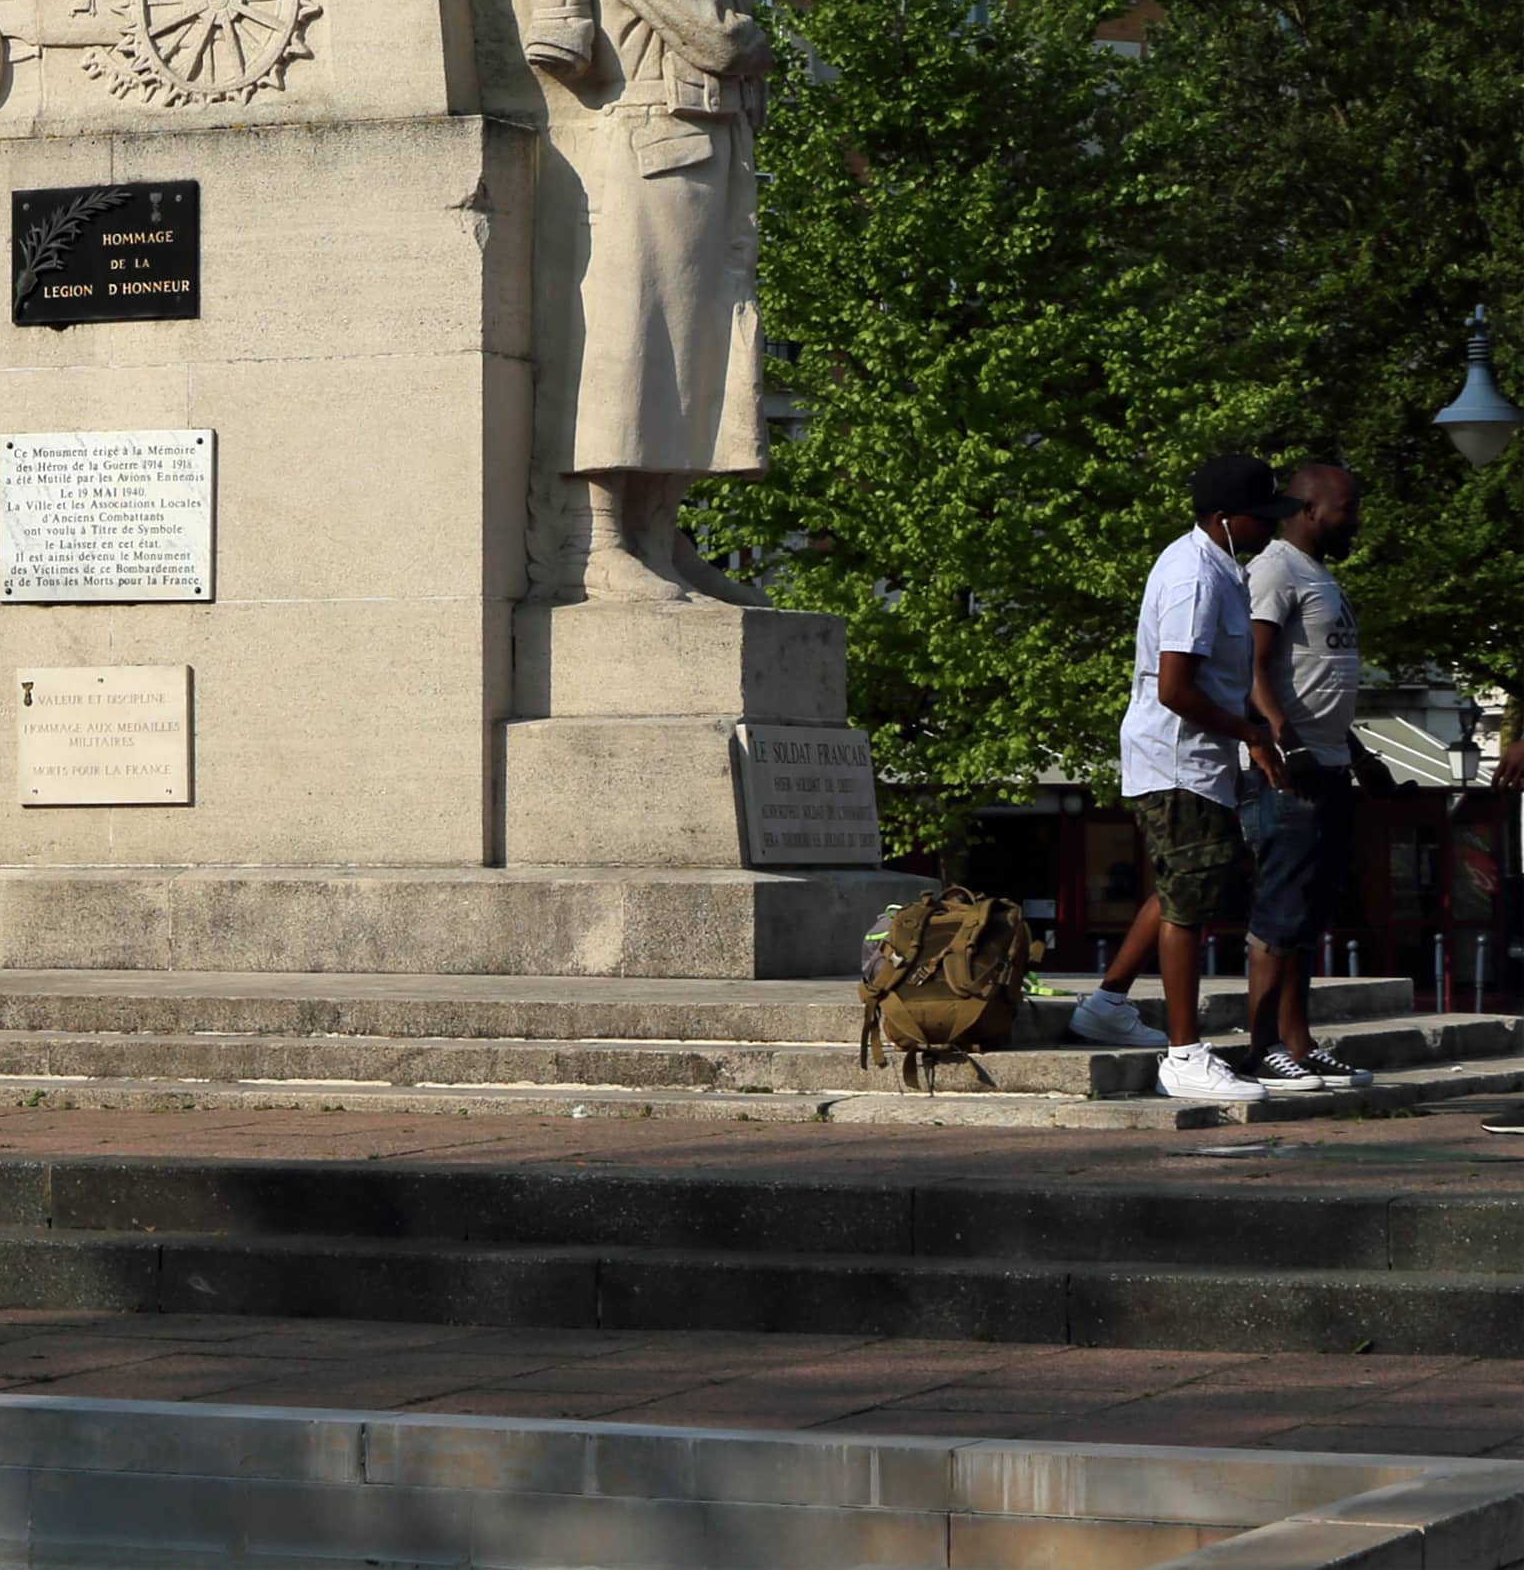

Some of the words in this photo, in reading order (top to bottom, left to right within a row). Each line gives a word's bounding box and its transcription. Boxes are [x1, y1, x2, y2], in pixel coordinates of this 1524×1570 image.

[102, 231, 174, 246] HOMMAGE
[110, 259, 126, 270] DE
[135, 258, 150, 268] LA
[44, 285, 93, 299] LEGION
[14, 449, 27, 458] Ce
[33, 448, 87, 458] Monument
[93, 447, 119, 460] érigé
[123, 447, 128, 455] à
[133, 446, 142, 455] la
[148, 446, 195, 455] Mémoire
[16, 462, 33, 472] des
[38, 462, 68, 472] Héros
[72, 462, 84, 471] de
[89, 461, 98, 470] la
[104, 460, 138, 470] Guerre
[143, 460, 162, 469] 1914
[17, 475, 32, 484] été
[38, 474, 71, 484] Mutilé
[77, 475, 94, 485] par
[100, 473, 112, 482] les
[118, 473, 151, 482] Avions
[157, 473, 204, 481] Ennemis
[61, 489, 74, 498] Le
[79, 488, 88, 497] 19
[94, 488, 117, 497] MAI
[7, 502, 20, 511] La
[26, 501, 52, 510] Ville
[57, 501, 66, 510] et
[72, 500, 85, 509] les
[90, 500, 155, 509] Associations
[160, 499, 201, 508] Locales
[42, 513, 94, 523] d'Anciens
[99, 513, 164, 521] Combattants
[24, 527, 41, 536] ont
[47, 526, 76, 535] voulu
[81, 525, 86, 535] à
[92, 525, 117, 534] Titre
[122, 525, 133, 534] de
[138, 524, 182, 536] Symbole
[46, 540, 54, 549] le
[60, 540, 96, 549] Laisser
[119, 540, 133, 548] cet
[16, 553, 23, 562] Il
[29, 554, 43, 562] est
[49, 553, 74, 561] ainsi
[79, 552, 115, 561] devenu
[121, 552, 129, 560] le
[134, 551, 190, 560] Monument
[11, 566, 27, 575] des
[33, 565, 79, 574] Victimes
[84, 565, 95, 574] de
[117, 564, 194, 573] Bombardement
[4, 577, 14, 587] et
[19, 577, 30, 587] de
[37, 577, 60, 586] Tous
[65, 577, 78, 586] les
[83, 576, 113, 585] Morts
[119, 577, 142, 587] pour
[148, 575, 156, 585] la
[38, 696, 83, 705] VALEUR
[88, 696, 101, 704] ET
[108, 693, 166, 705] DISCIPLINE
[24, 723, 83, 734] HOMMAGE
[87, 723, 112, 732] AUX
[117, 722, 180, 732] MEDAILLES
[69, 737, 135, 747] MILITAIRES
[754, 741, 766, 763] LE
[773, 742, 810, 763] SOLDAT
[817, 743, 868, 767] FRANÇAIS
[33, 766, 69, 776] MORTS
[72, 766, 100, 776] POUR
[105, 766, 121, 775] LA
[126, 765, 172, 774] FRANCE
